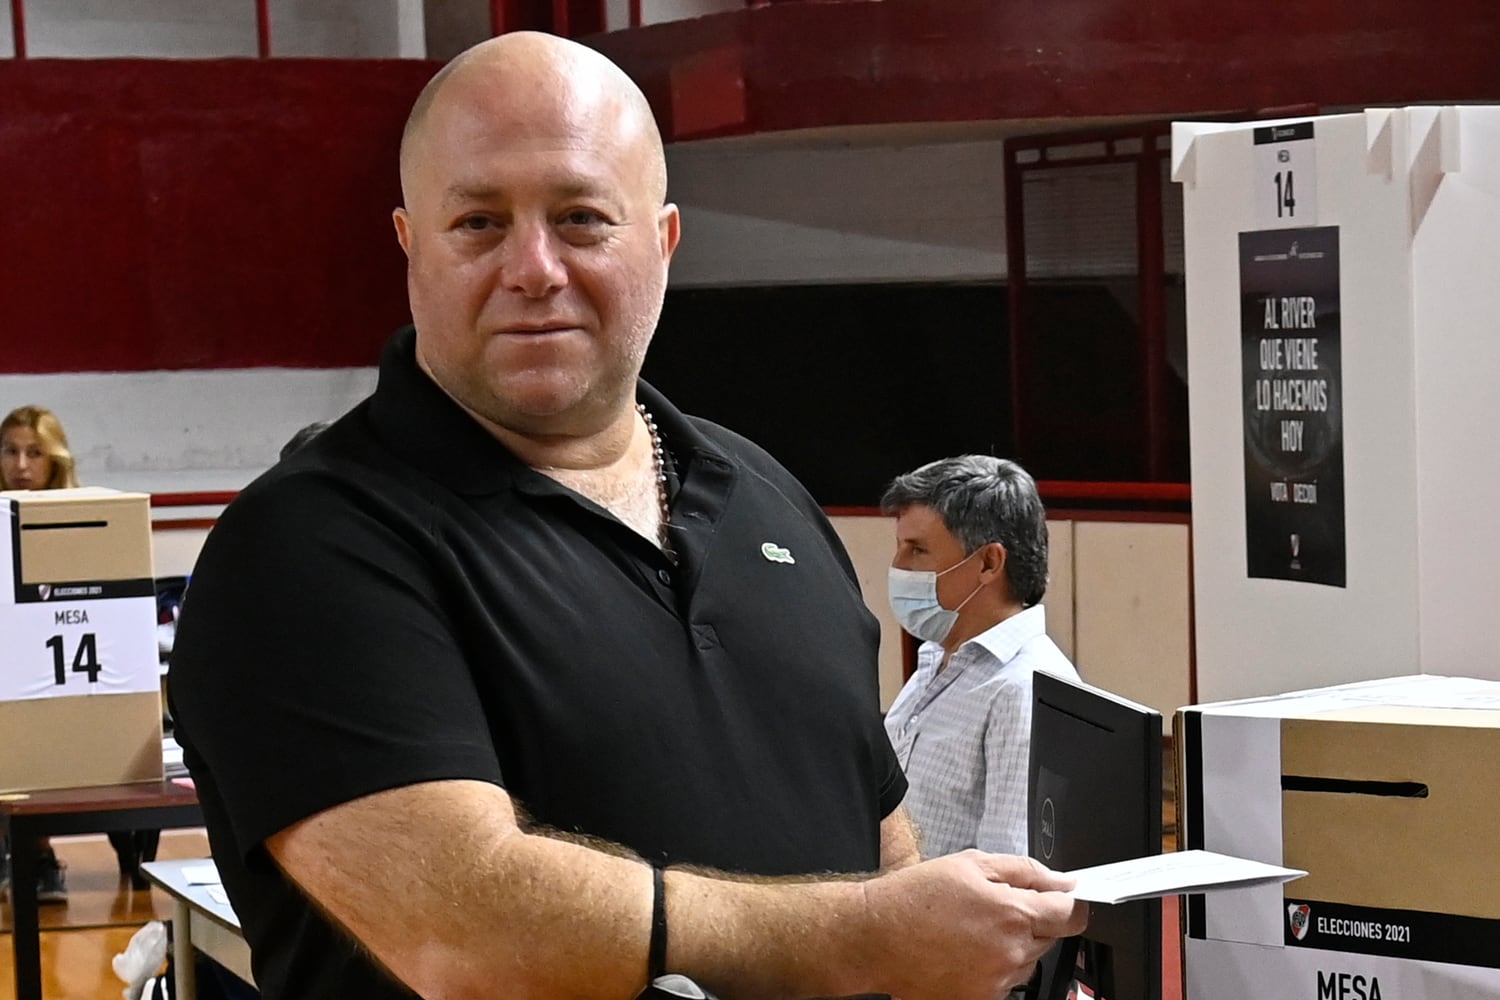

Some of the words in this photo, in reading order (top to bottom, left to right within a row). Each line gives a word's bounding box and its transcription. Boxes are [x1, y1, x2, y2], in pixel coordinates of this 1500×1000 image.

[1274, 171, 1295, 217] 14
[1264, 298, 1279, 329] AL
[1281, 297, 1315, 329] RIVER
[1260, 339, 1282, 370] QUE
[1284, 338, 1318, 370] VIENE
[1256, 380, 1270, 411] LO
[1273, 380, 1327, 412] HACEMOS
[1281, 420, 1303, 452] HOY
[55, 609, 89, 625] MESA
[46, 633, 102, 685] 14
[1317, 917, 1383, 940] ELECCIONES
[1385, 924, 1411, 943] 2021
